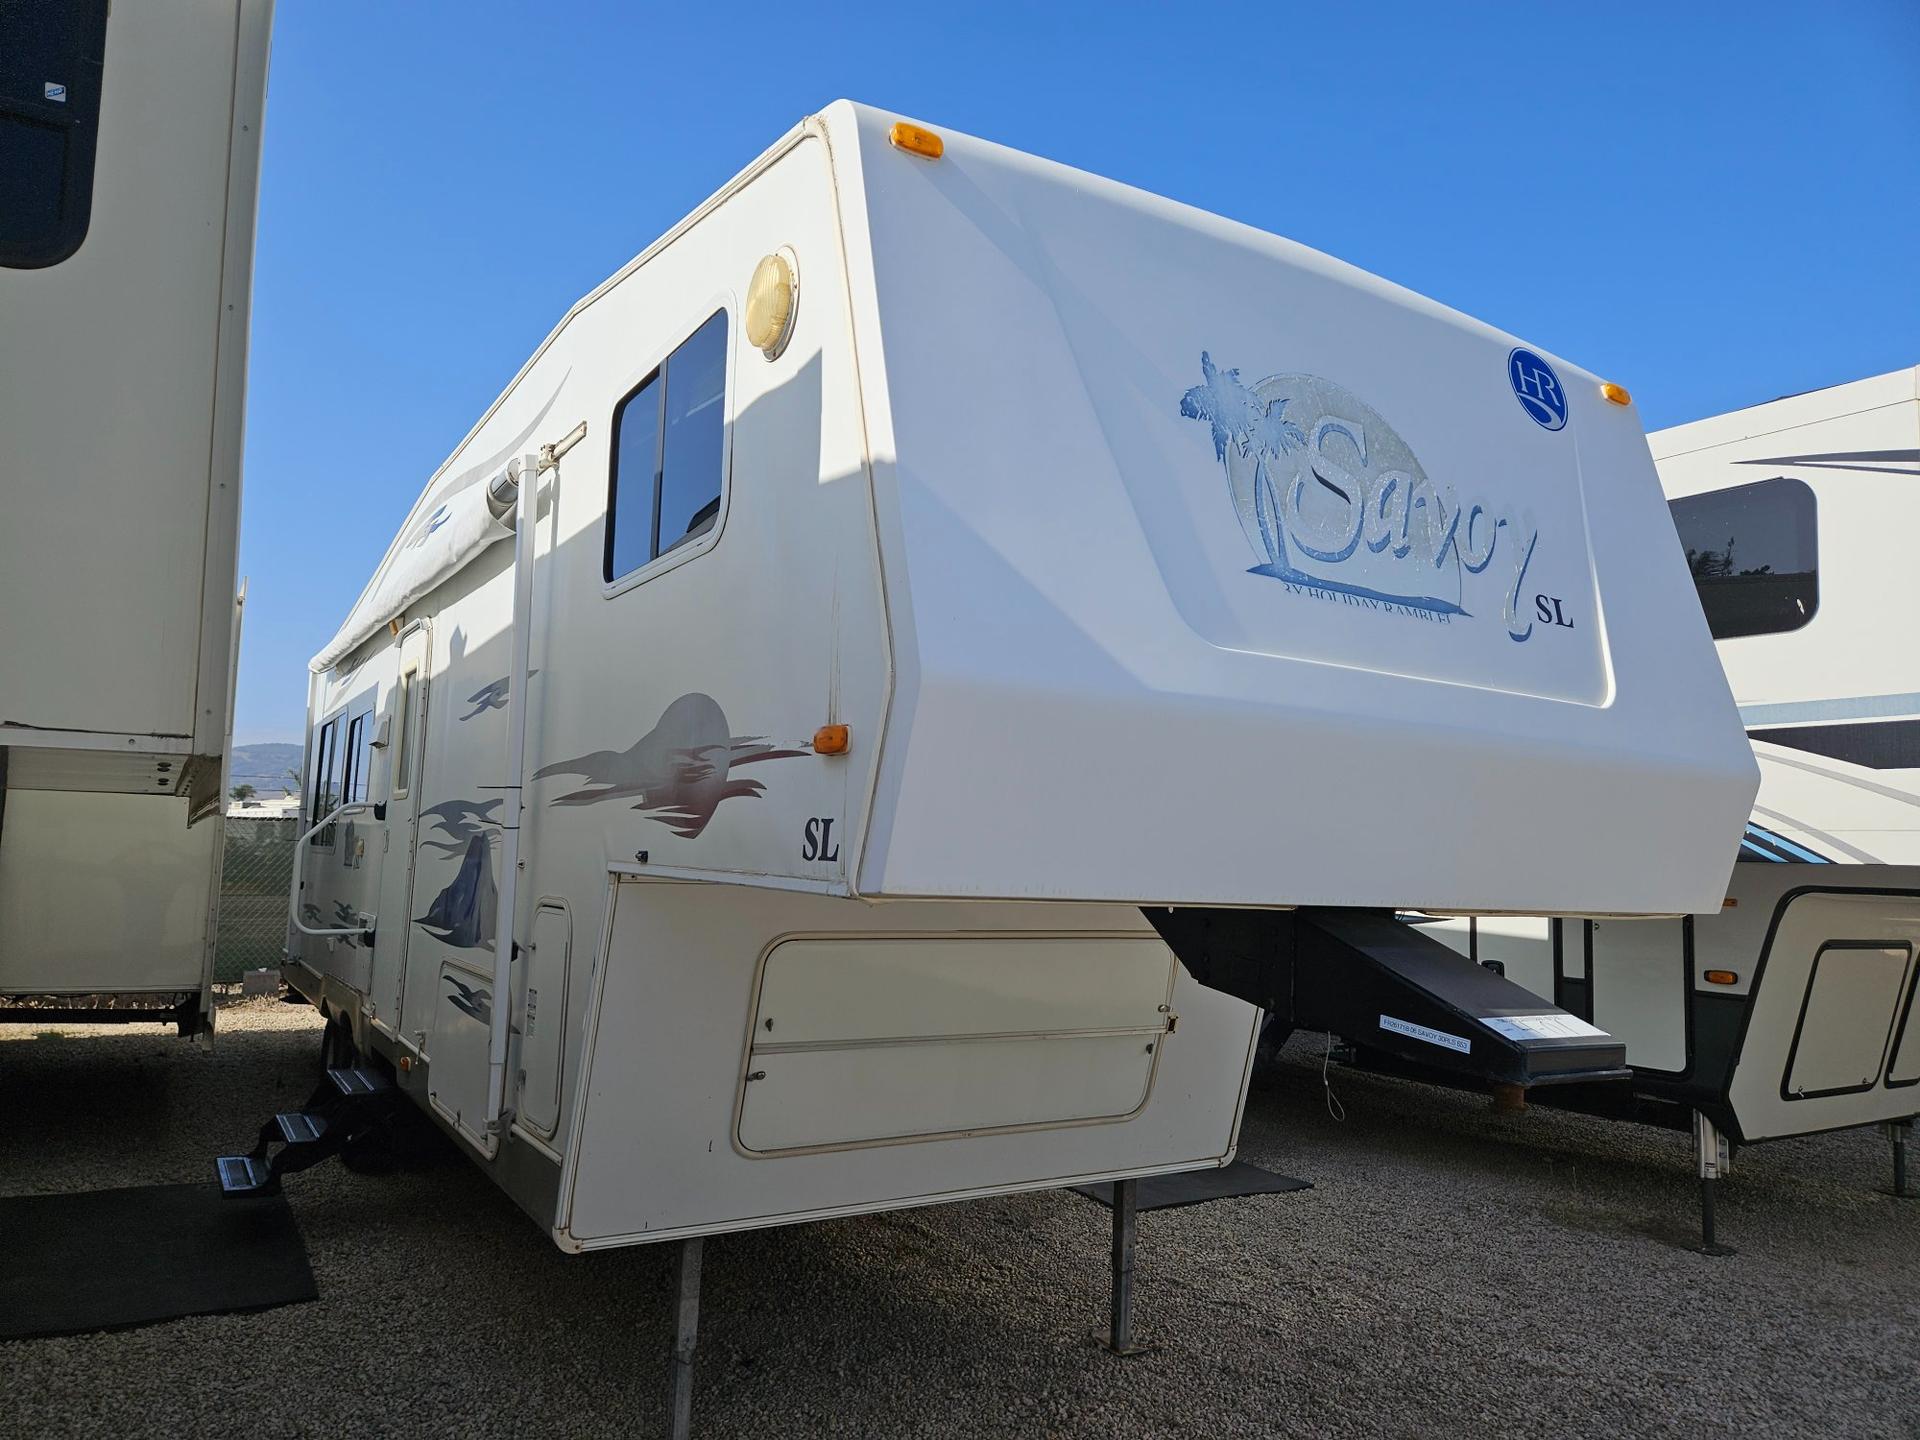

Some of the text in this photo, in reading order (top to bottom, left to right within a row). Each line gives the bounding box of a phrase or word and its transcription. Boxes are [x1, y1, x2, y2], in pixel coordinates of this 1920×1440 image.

[1516, 360, 1561, 407] HR
[1285, 414, 1538, 643] Savoy
[1535, 594, 1575, 629] SL
[802, 817, 839, 861] SL
[1417, 1028, 1438, 1040] SAVOY
